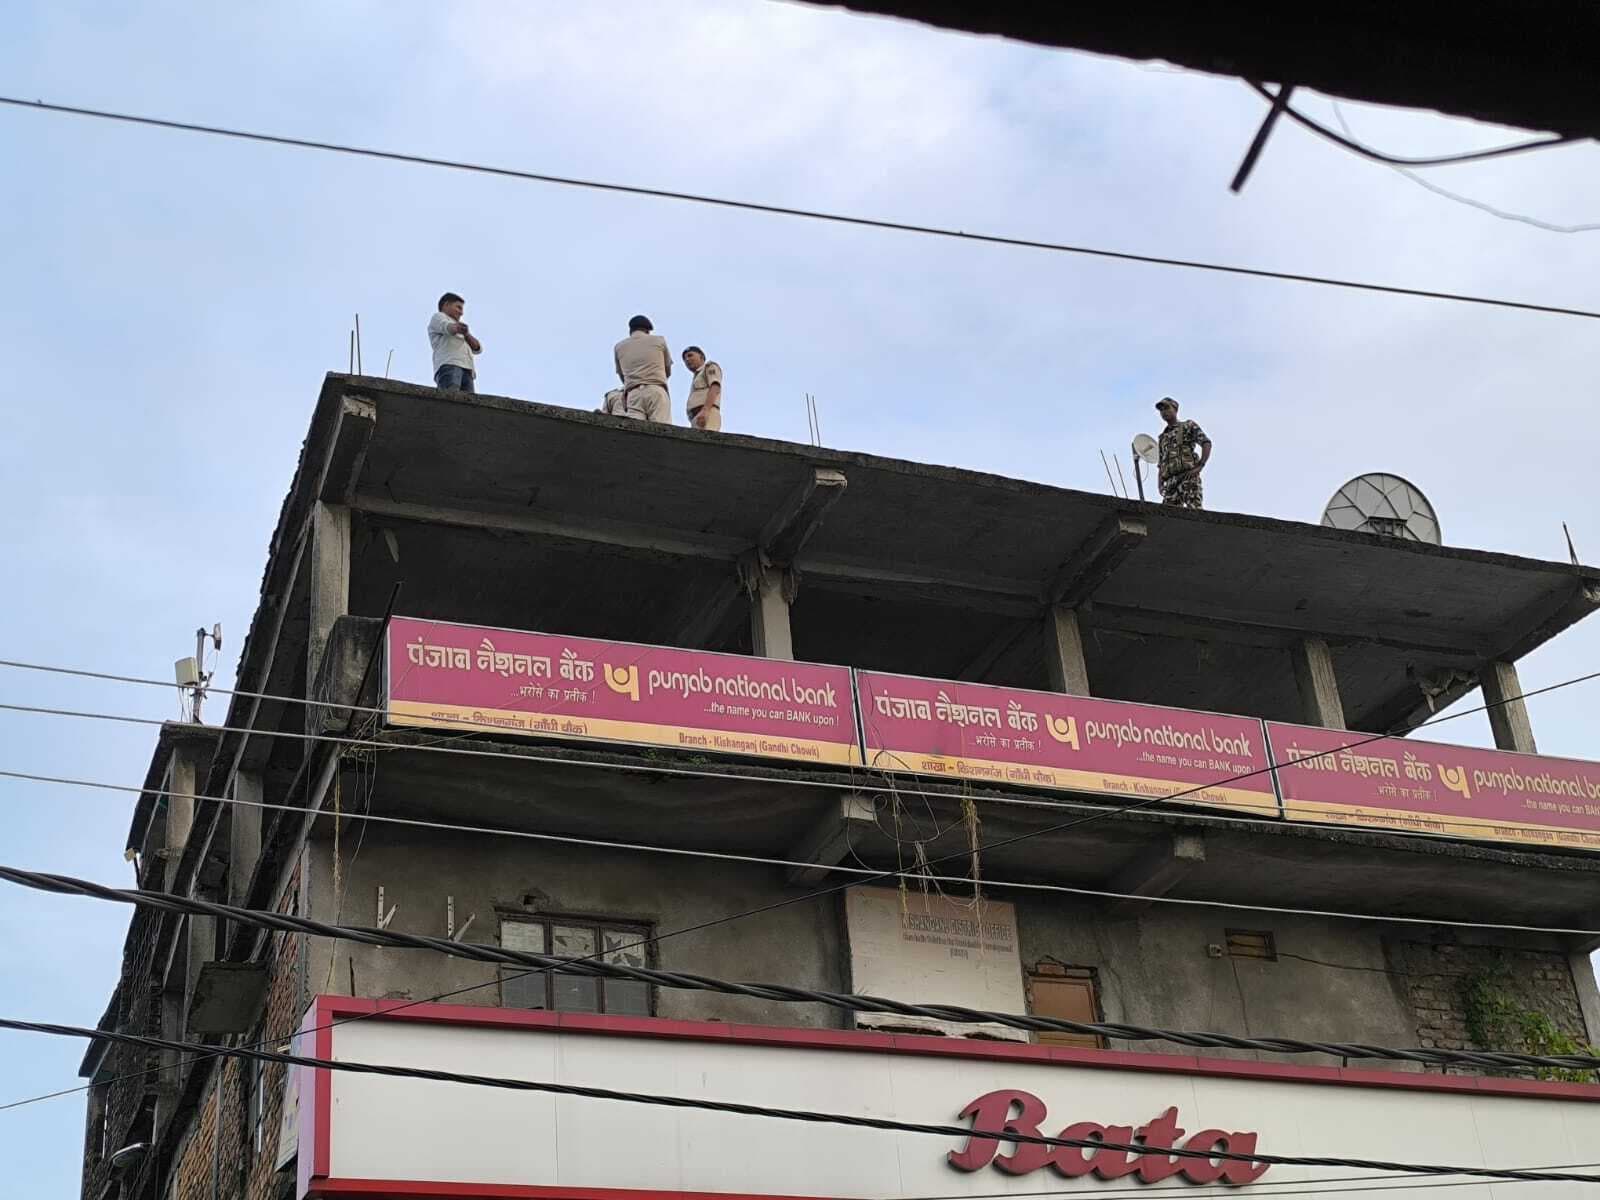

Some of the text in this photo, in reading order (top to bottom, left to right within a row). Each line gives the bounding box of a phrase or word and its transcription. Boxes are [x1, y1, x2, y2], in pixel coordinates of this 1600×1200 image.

[406, 636, 594, 681] पंजाब नैशनल बैंक
[648, 667, 837, 707] punjab national bank
[726, 705, 750, 717] name
[751, 708, 767, 720] you
[769, 709, 785, 720] can
[786, 710, 811, 723] BANK
[813, 714, 834, 727] upon
[874, 689, 1038, 732] पंजाब नैशनल बैंक
[679, 732, 708, 745] Branch
[1085, 718, 1253, 758] punjab national bank
[1156, 754, 1177, 765] name
[1179, 757, 1193, 769] you
[1194, 758, 1208, 769] can
[1208, 759, 1231, 772] BANK
[1286, 741, 1432, 782] पंजाब नैशनल बैंक
[1473, 767, 1524, 796] punjab
[1525, 773, 1586, 798] national
[947, 1089, 1271, 1186] Bata
